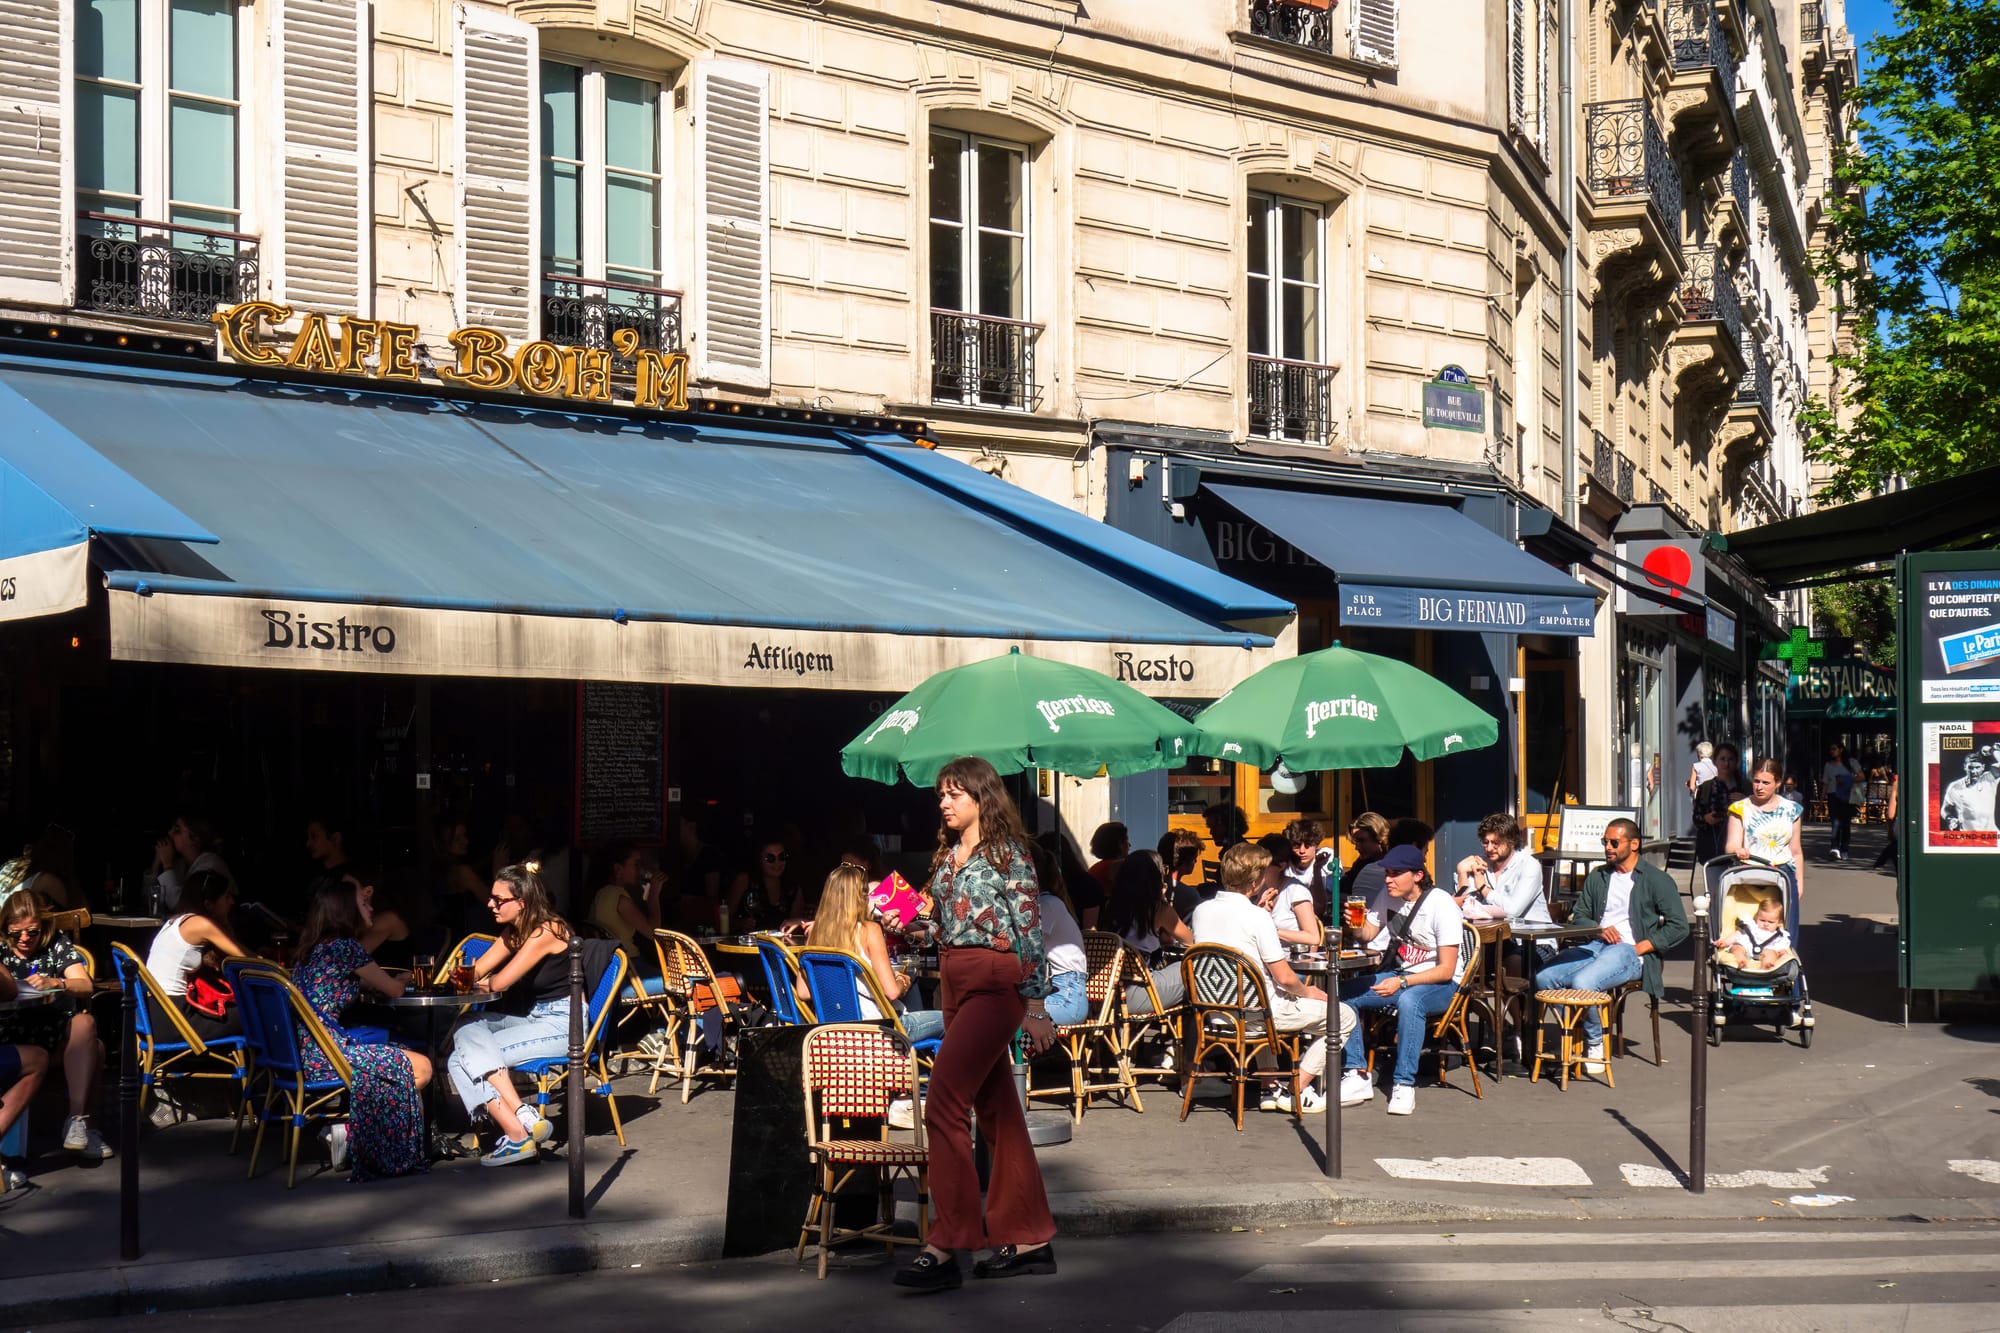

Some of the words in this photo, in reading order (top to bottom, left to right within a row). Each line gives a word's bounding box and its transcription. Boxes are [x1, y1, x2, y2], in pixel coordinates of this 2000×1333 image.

[1448, 396, 1462, 406] RUE
[1426, 407, 1436, 417] DE
[1436, 408, 1482, 422] TOCQUEVILLE
[1216, 521, 1276, 563] BIG
[1945, 581, 1952, 591] A
[1952, 580, 1969, 590] DES
[1970, 579, 2000, 590] DIMAN
[1353, 595, 1375, 605] SUR
[1929, 595, 1945, 605] QUI
[1946, 593, 1993, 604] COMPTENT
[1347, 606, 1382, 617] PLACE
[1419, 598, 1452, 622] BIG
[1457, 600, 1526, 625] FERNAND
[1929, 609, 1947, 619] QUE
[1540, 615, 1591, 627] EMPORTER
[261, 609, 396, 654] Bistro
[1962, 641, 1976, 654] Le
[743, 642, 834, 676] Affligem
[1114, 652, 1195, 682] Resto
[1798, 664, 1897, 699] RESTAURAN
[1036, 694, 1116, 733] perrier
[1304, 694, 1378, 739] perrier
